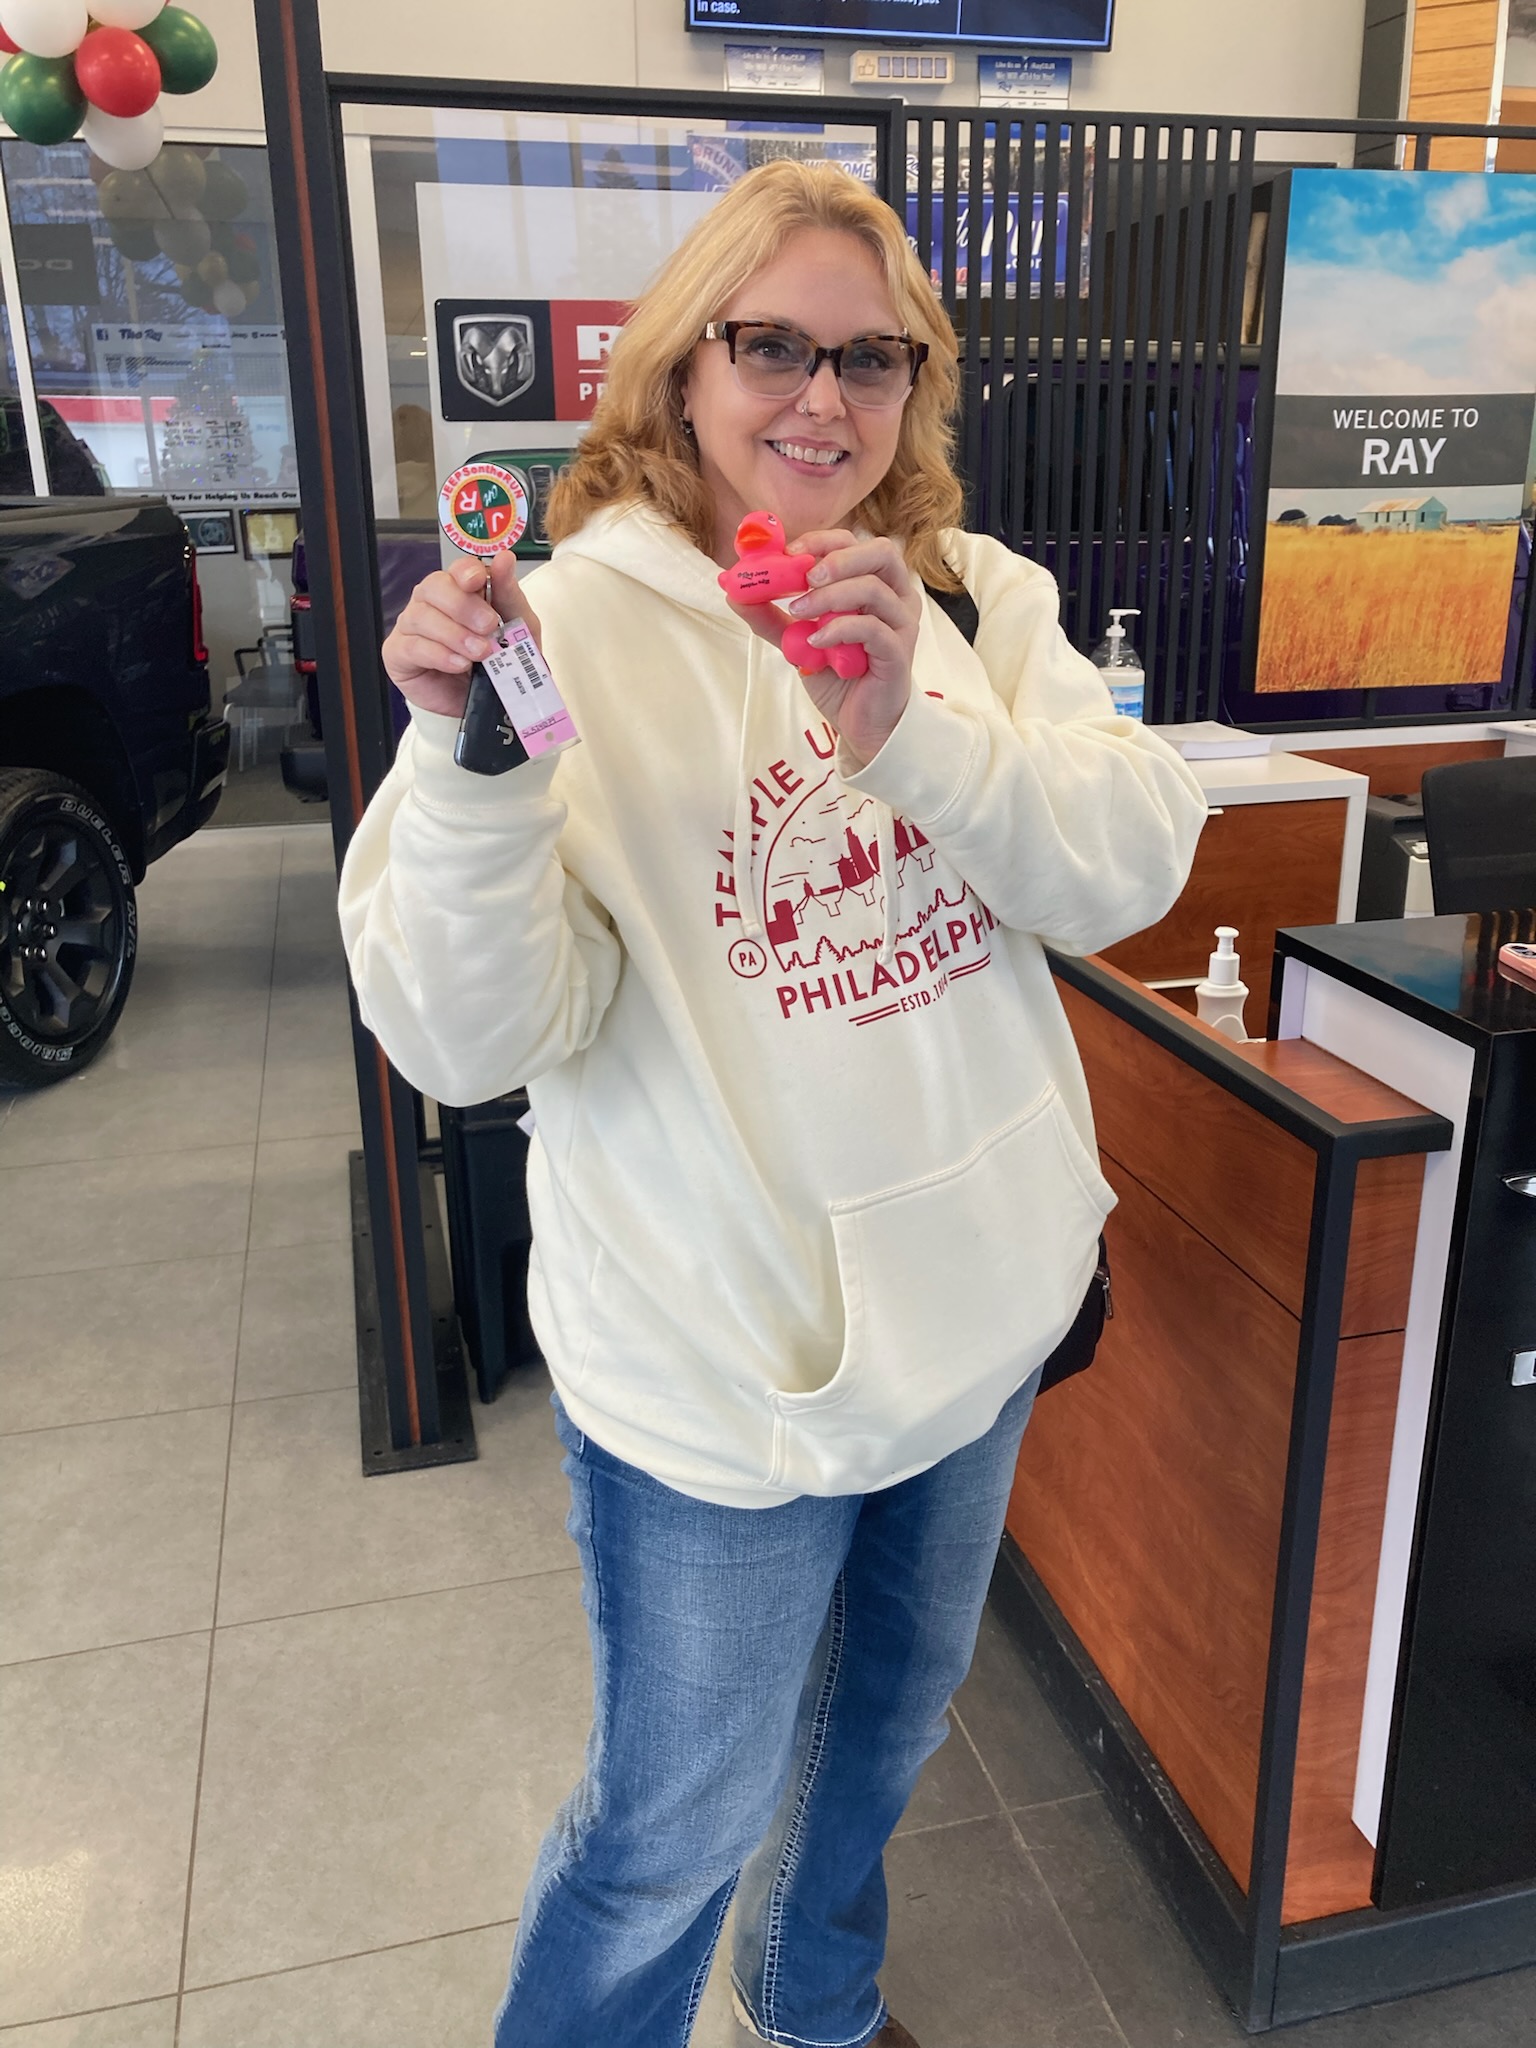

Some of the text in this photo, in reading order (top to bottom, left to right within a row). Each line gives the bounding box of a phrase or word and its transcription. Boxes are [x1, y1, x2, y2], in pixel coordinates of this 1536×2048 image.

[697, 0, 708, 12] in
[805, 160, 873, 179] WEOME
[1332, 407, 1479, 430] WELCOME TO
[1360, 437, 1448, 476] RAY
[441, 465, 524, 500] JEEPSontheRUN
[205, 493, 238, 502] Helping
[60, 799, 131, 885] DUELER
[738, 952, 758, 968] PA
[776, 902, 1000, 1019] PHILADELPHI
